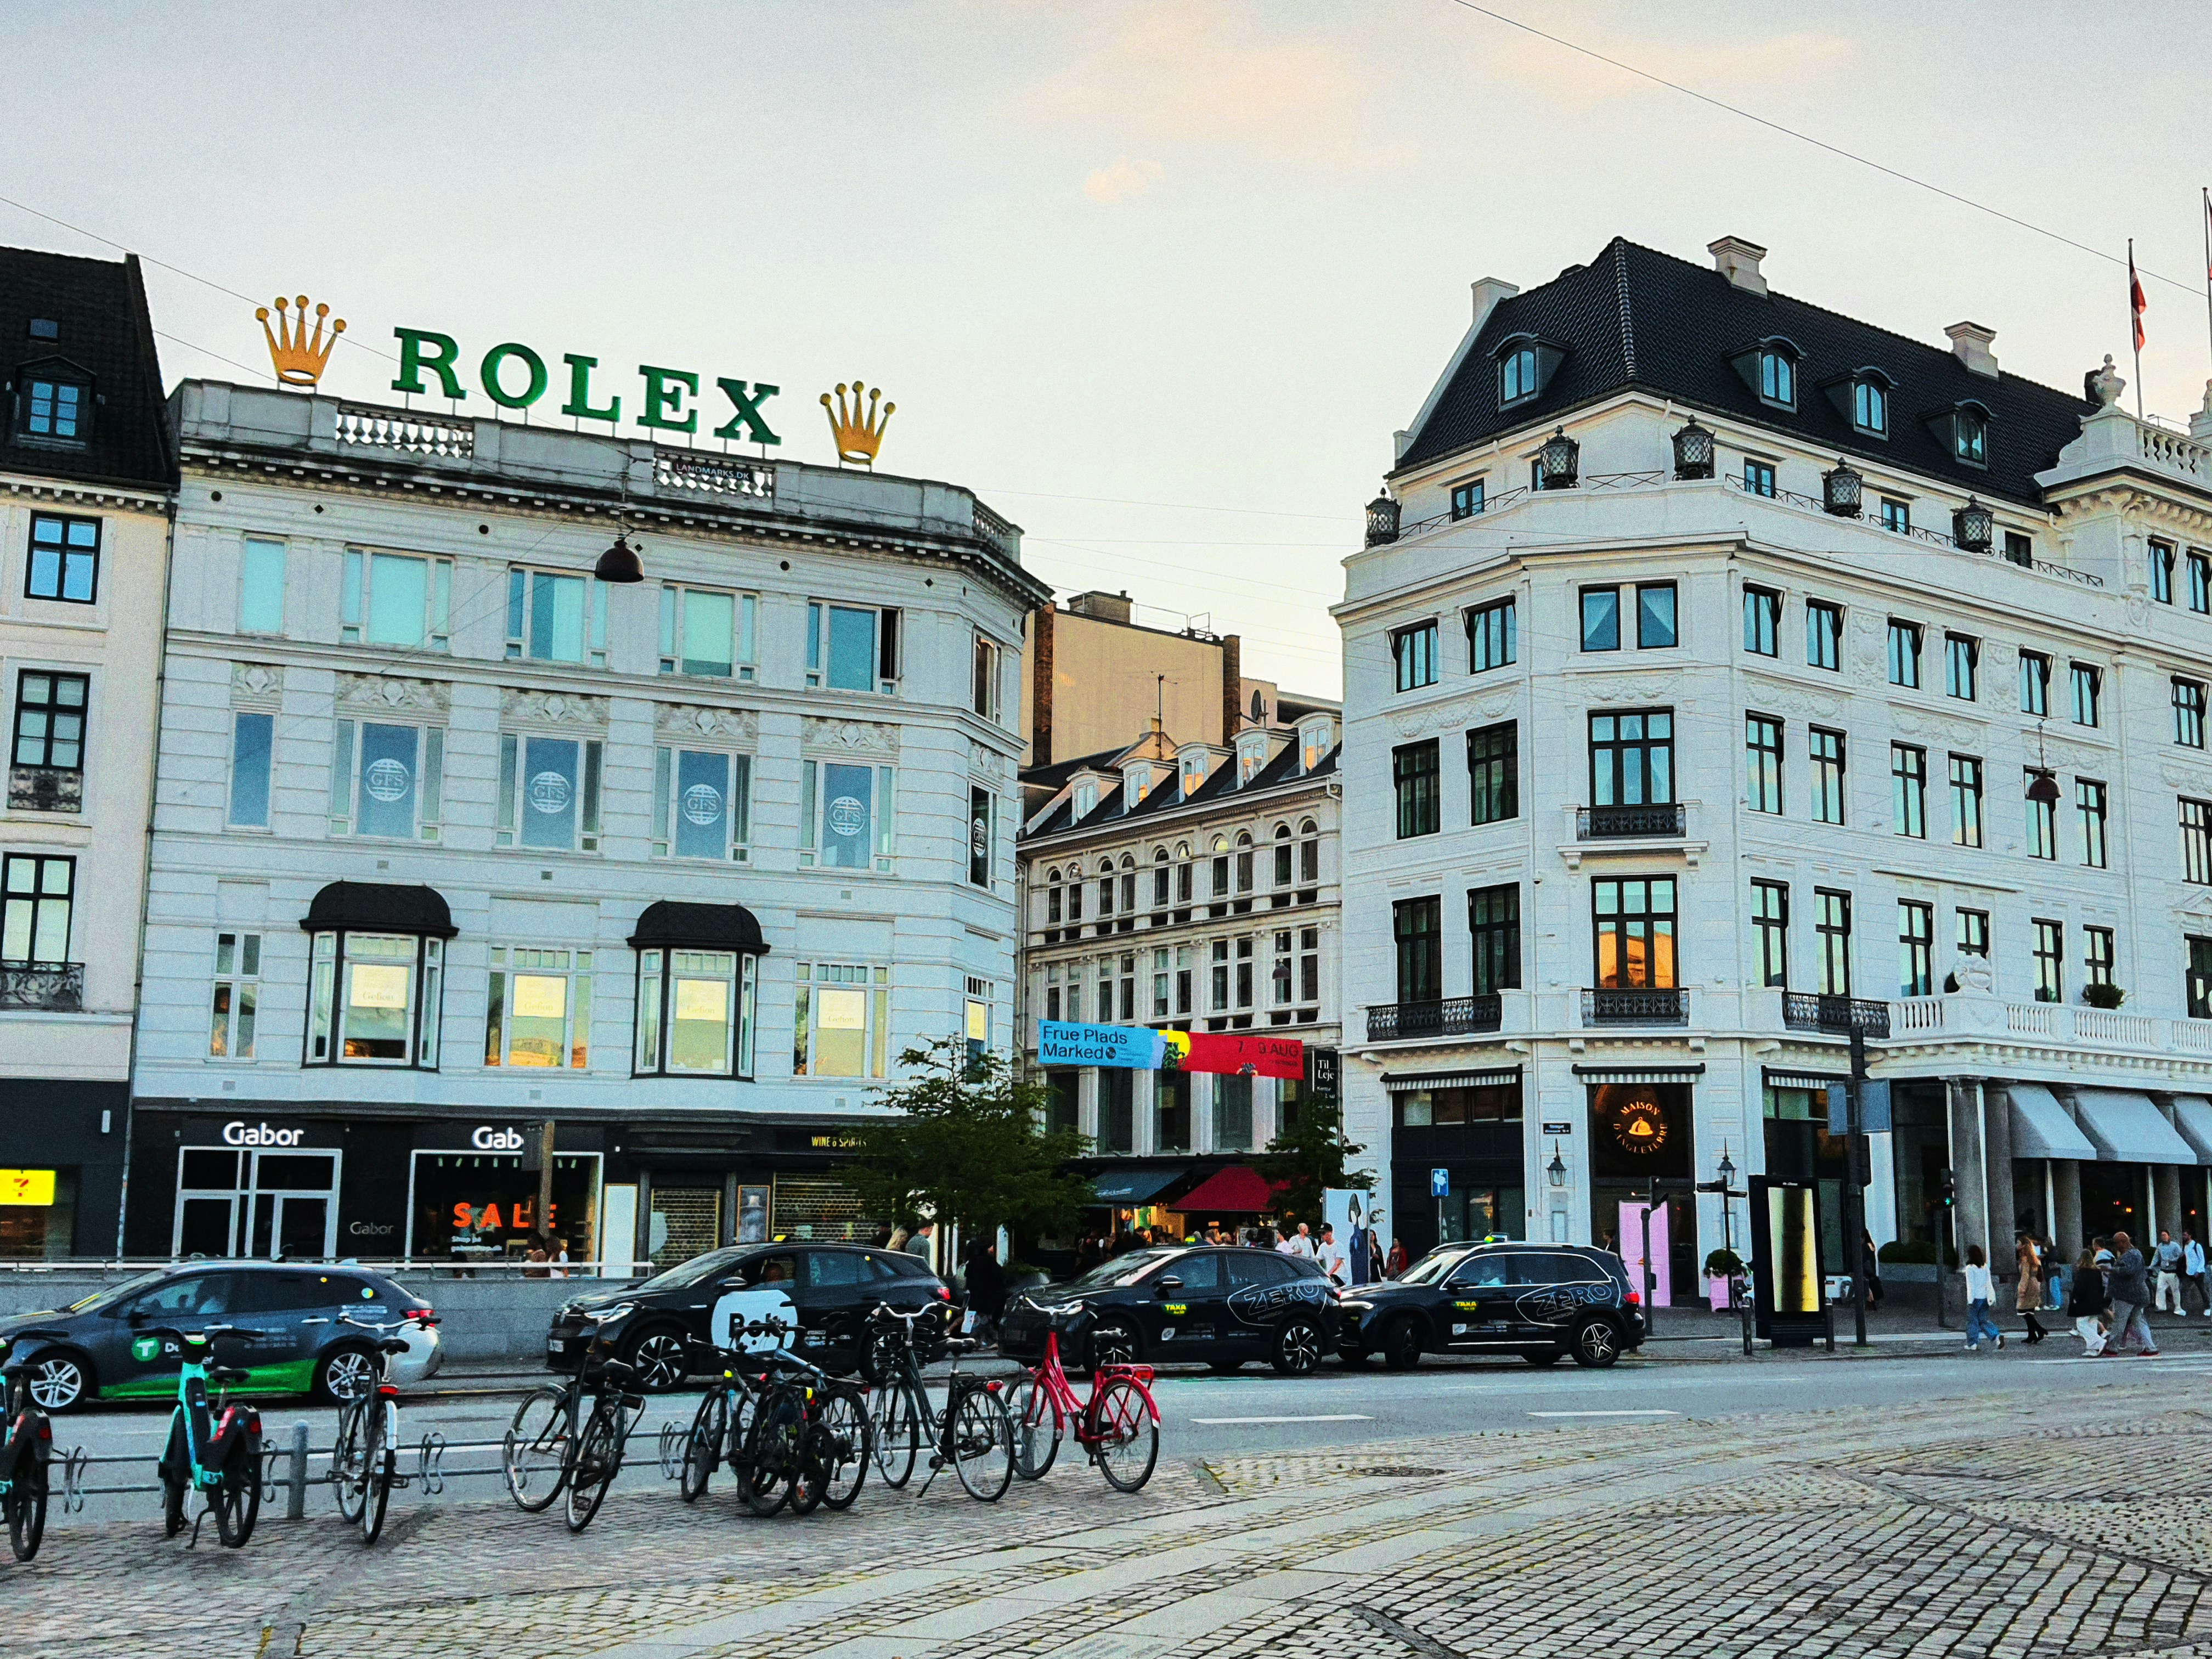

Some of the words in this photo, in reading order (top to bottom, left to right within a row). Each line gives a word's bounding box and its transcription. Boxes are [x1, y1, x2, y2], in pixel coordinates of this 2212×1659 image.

[391, 326, 781, 445] ROLEX
[676, 464, 749, 480] LANDMARKS.DK
[371, 772, 404, 787] GFS
[534, 785, 565, 799] GFS
[687, 797, 717, 811] GFS
[832, 809, 861, 822] GFS
[1043, 1025, 1080, 1041] Frue
[1084, 1029, 1127, 1045] Plads
[1043, 1042, 1104, 1060] Marked
[1270, 1043, 1299, 1058] AUG
[1318, 1059, 1329, 1069] Til
[1318, 1069, 1334, 1082] Leje
[1621, 1101, 1660, 1115] MAISON
[223, 1121, 304, 1146] Gabor
[472, 1126, 524, 1149] Gab
[811, 1136, 831, 1147] WINE
[350, 1221, 394, 1234] Gabor
[1243, 1279, 1319, 1316] ZERO
[1533, 1283, 1612, 1316] ZERO
